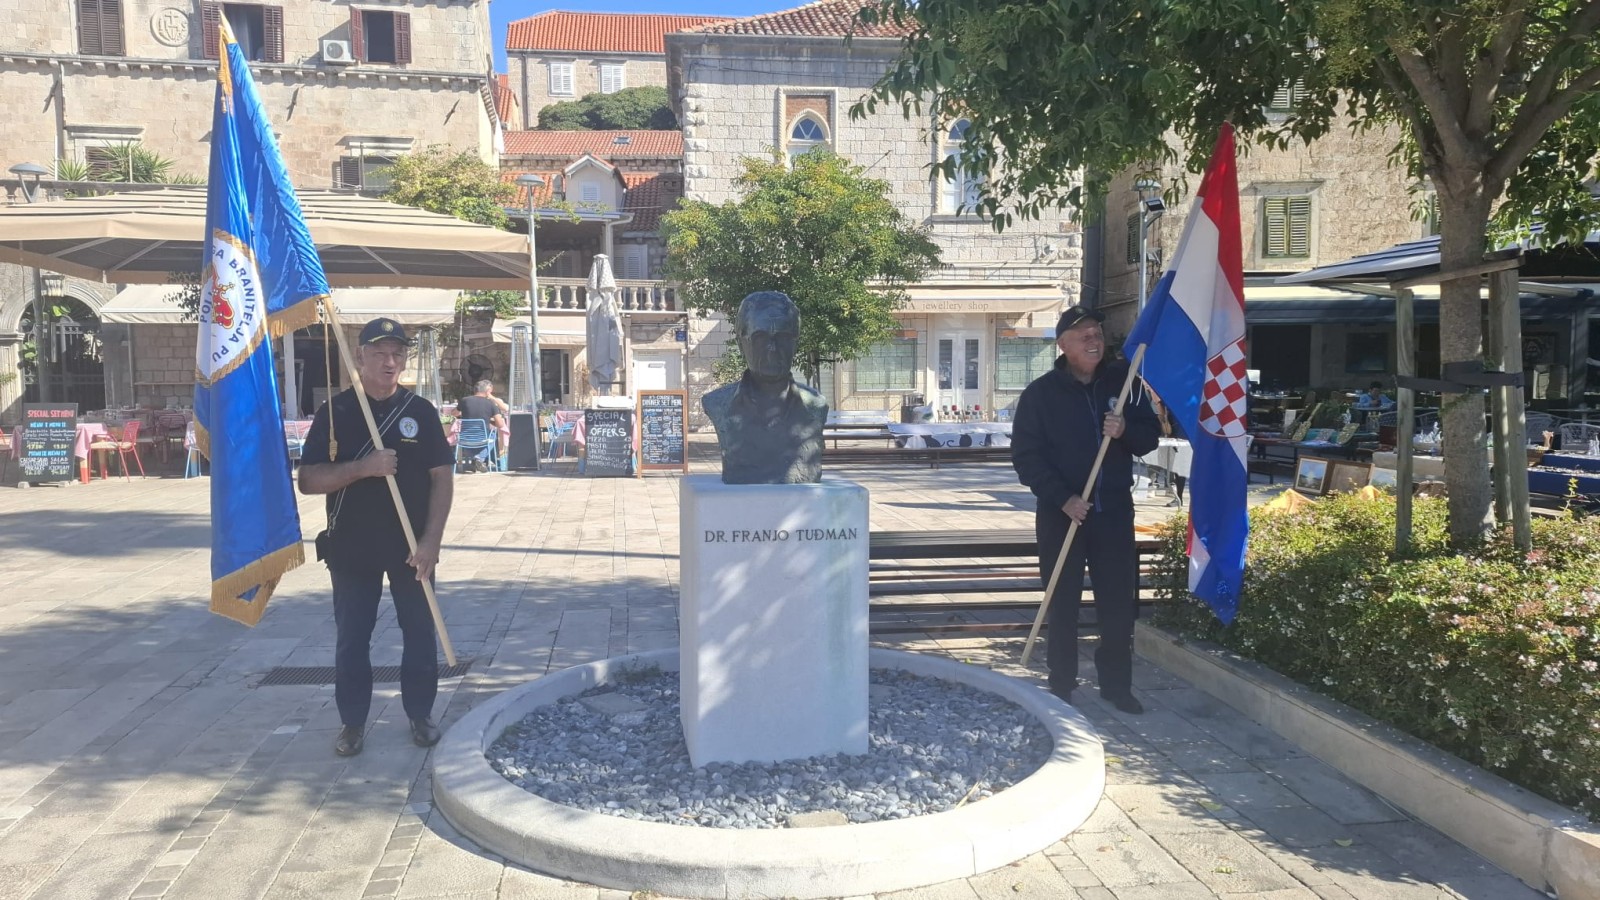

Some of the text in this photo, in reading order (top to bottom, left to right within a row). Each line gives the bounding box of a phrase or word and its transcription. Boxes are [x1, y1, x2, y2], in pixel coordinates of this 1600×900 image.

[228, 258, 255, 344] BRANITELJA
[922, 301, 963, 312] jewellery
[968, 301, 989, 312] shop
[27, 409, 50, 418] SPECIAL
[587, 411, 626, 422] SPECIAL
[593, 420, 618, 428] LUNCH
[590, 427, 627, 438] OFFERS
[704, 528, 858, 543] DR. FRANJO TUĐMAN
